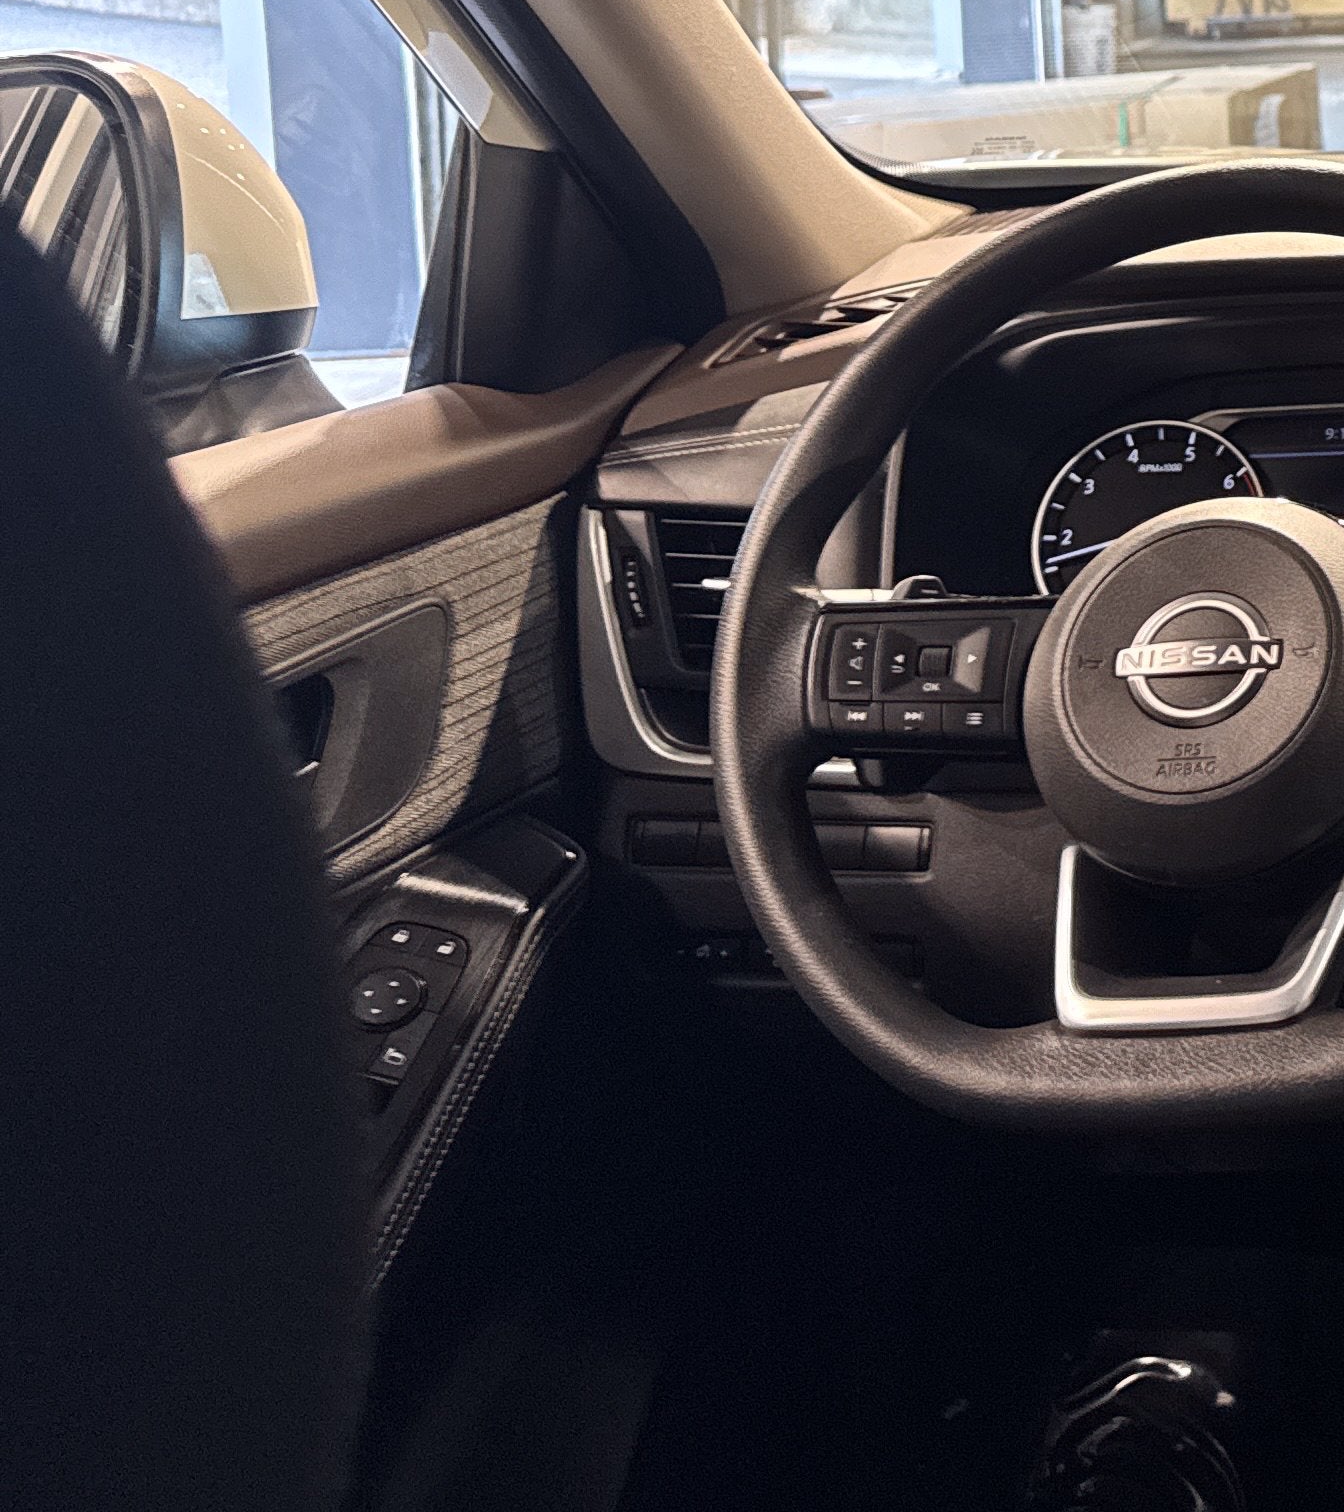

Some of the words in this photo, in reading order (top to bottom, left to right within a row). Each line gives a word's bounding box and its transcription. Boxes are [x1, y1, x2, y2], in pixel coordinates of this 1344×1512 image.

[1127, 449, 1139, 463] 4
[1184, 446, 1196, 462] 5
[1083, 478, 1095, 495] 3
[1223, 473, 1235, 489] 6
[1060, 529, 1074, 546] 2
[1121, 644, 1280, 670] NISSAN
[922, 682, 941, 692] OK
[1174, 743, 1202, 757] SRS
[1156, 761, 1217, 777] AIRBAG
